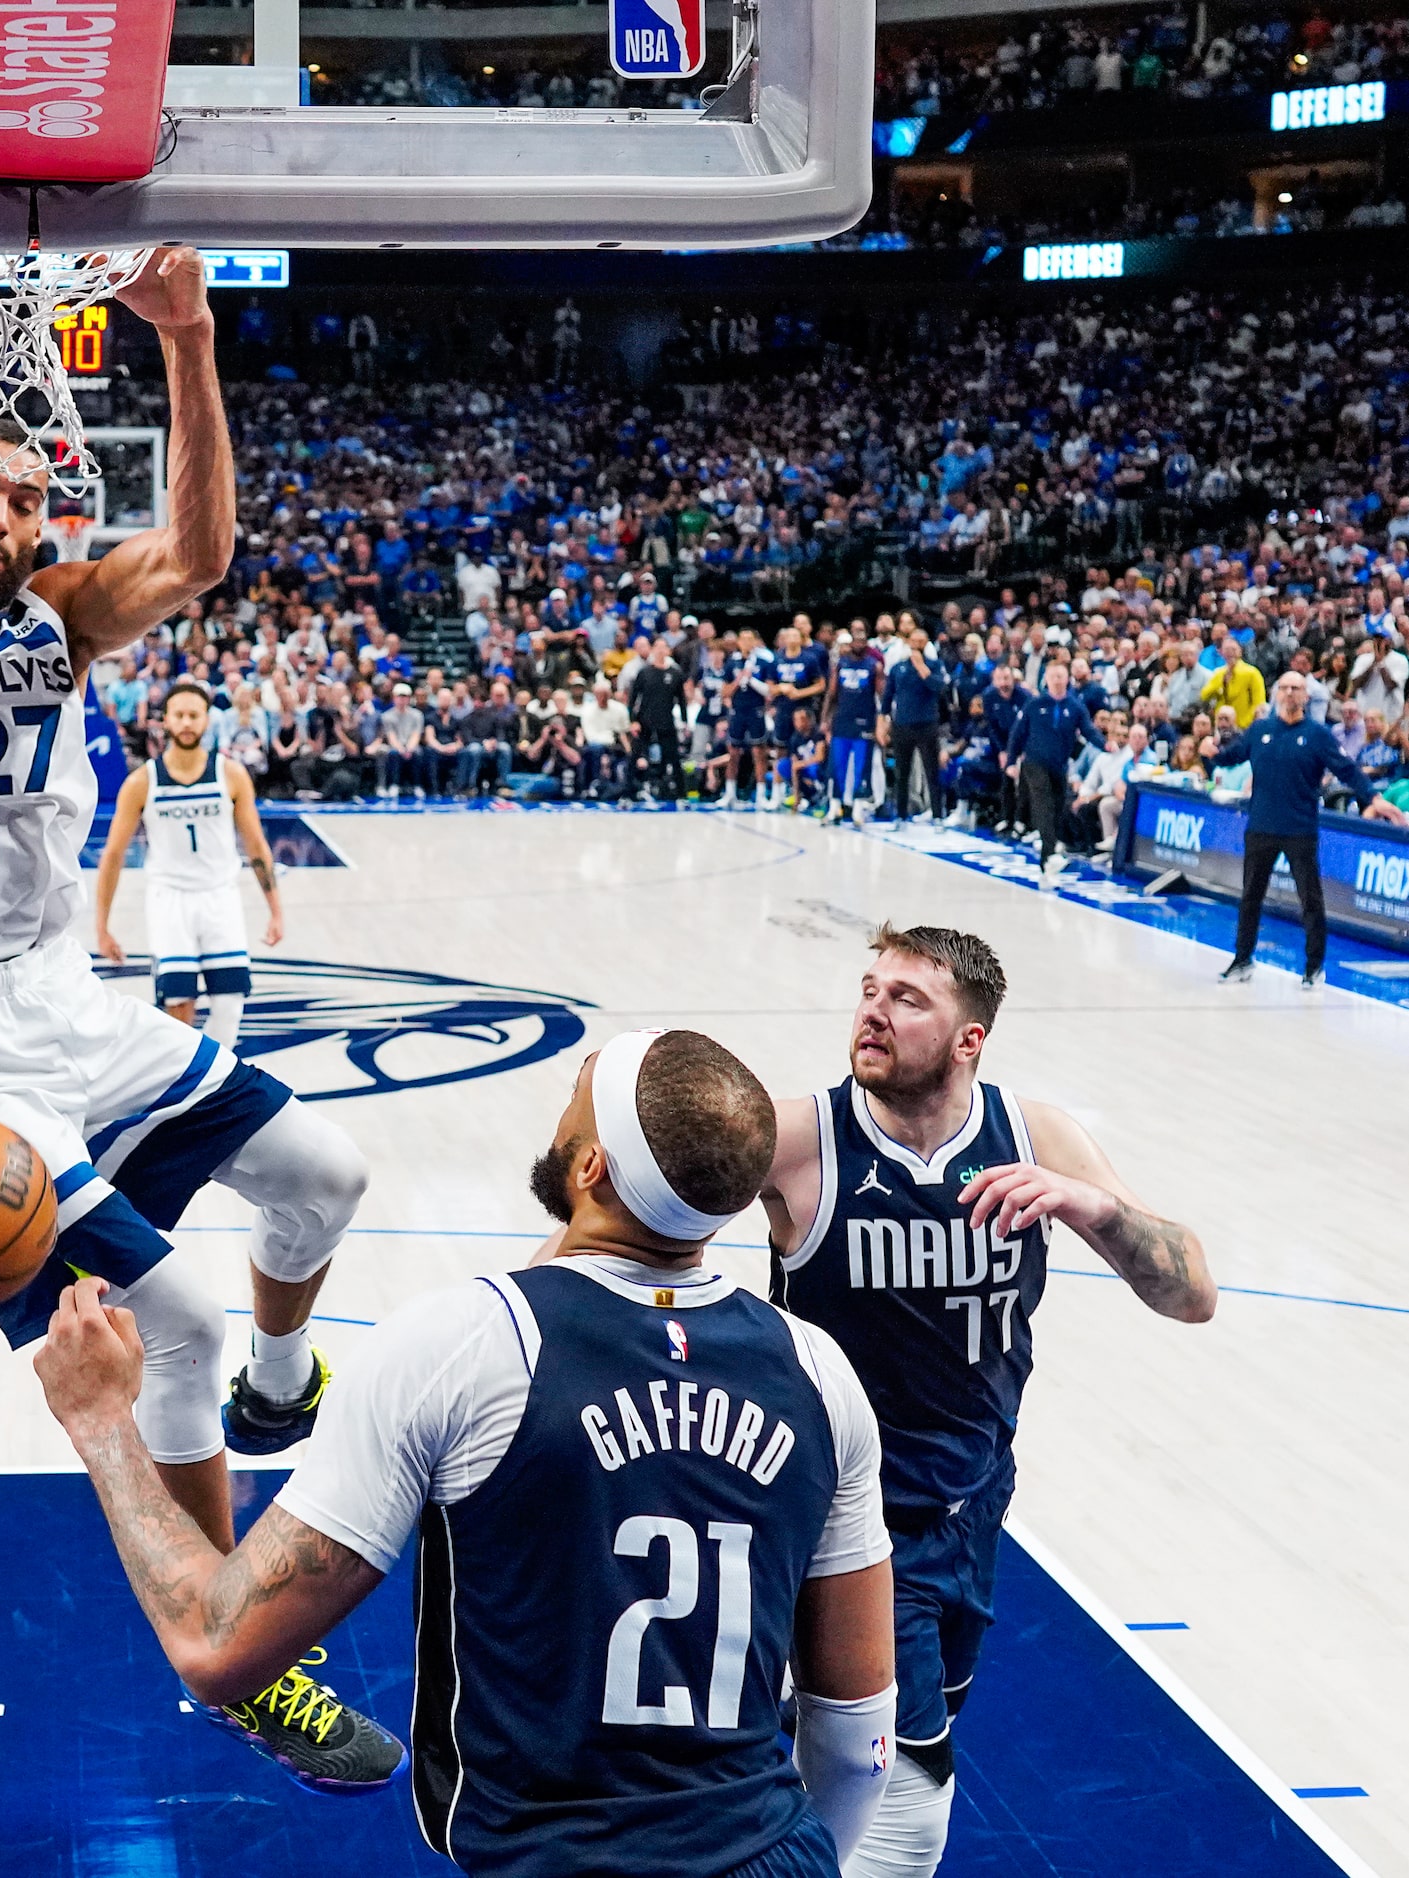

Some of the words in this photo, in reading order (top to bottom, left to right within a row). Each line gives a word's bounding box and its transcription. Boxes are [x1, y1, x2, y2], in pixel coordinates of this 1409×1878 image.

[625, 29, 669, 63] NBA
[1270, 81, 1386, 131] DEFENSE!
[1022, 242, 1124, 281] DEFENSE!
[61, 328, 102, 371] 10
[157, 804, 221, 820] WOLVES
[1155, 808, 1205, 852] max
[186, 823, 198, 853] 1
[846, 1209, 1023, 1289] MAVS
[945, 1288, 1020, 1366] 77
[580, 1379, 796, 1486] GAFFORD
[602, 1515, 753, 1730] 21
